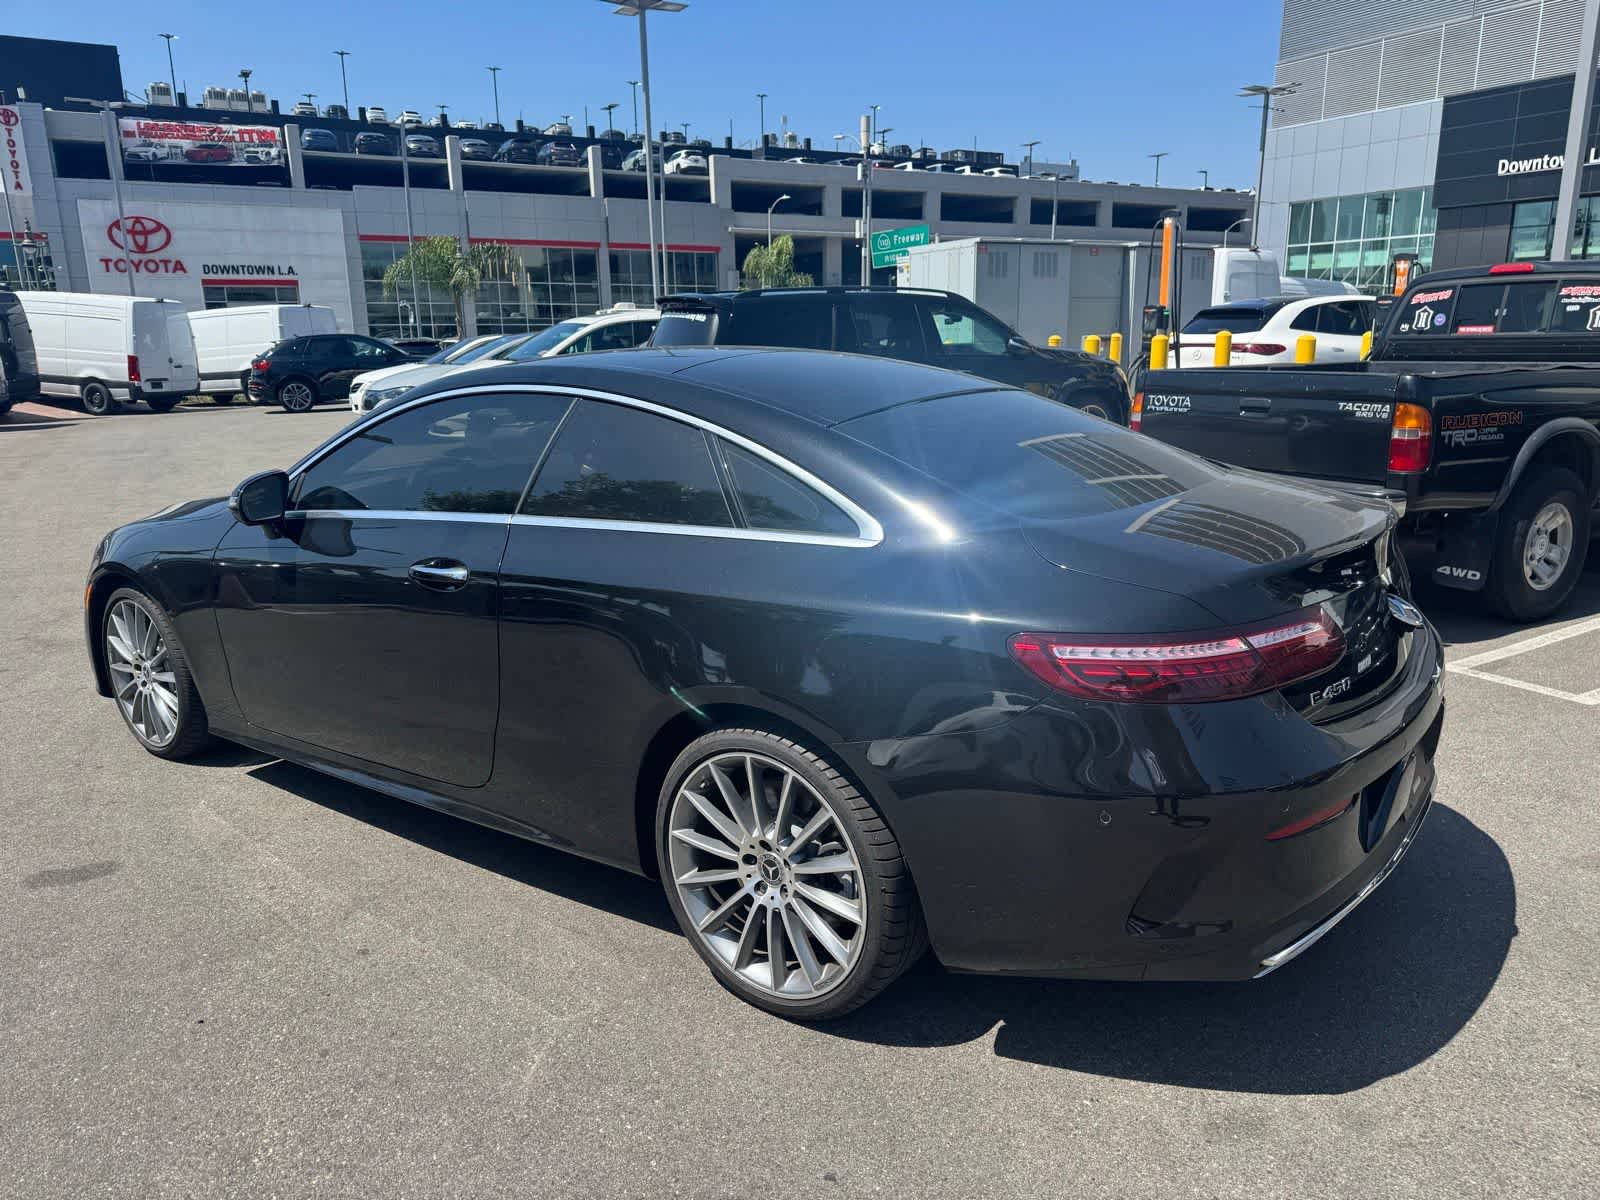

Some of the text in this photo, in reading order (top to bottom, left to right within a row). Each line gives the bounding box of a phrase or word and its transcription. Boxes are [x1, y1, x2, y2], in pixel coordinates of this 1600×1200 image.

[4, 127, 24, 191] TOYOTA
[893, 233, 925, 245] Freeway
[100, 258, 188, 274] TOYOTA
[203, 264, 299, 277] DOWNTOWN L.A.
[1148, 395, 1191, 407] TOYOTA
[1338, 402, 1391, 412] TACOMA
[1375, 411, 1389, 419] V6
[1441, 411, 1523, 430] RUBICON
[1440, 428, 1478, 448] TRD
[1436, 565, 1481, 581] 4WD
[1310, 676, 1351, 706] E 450
